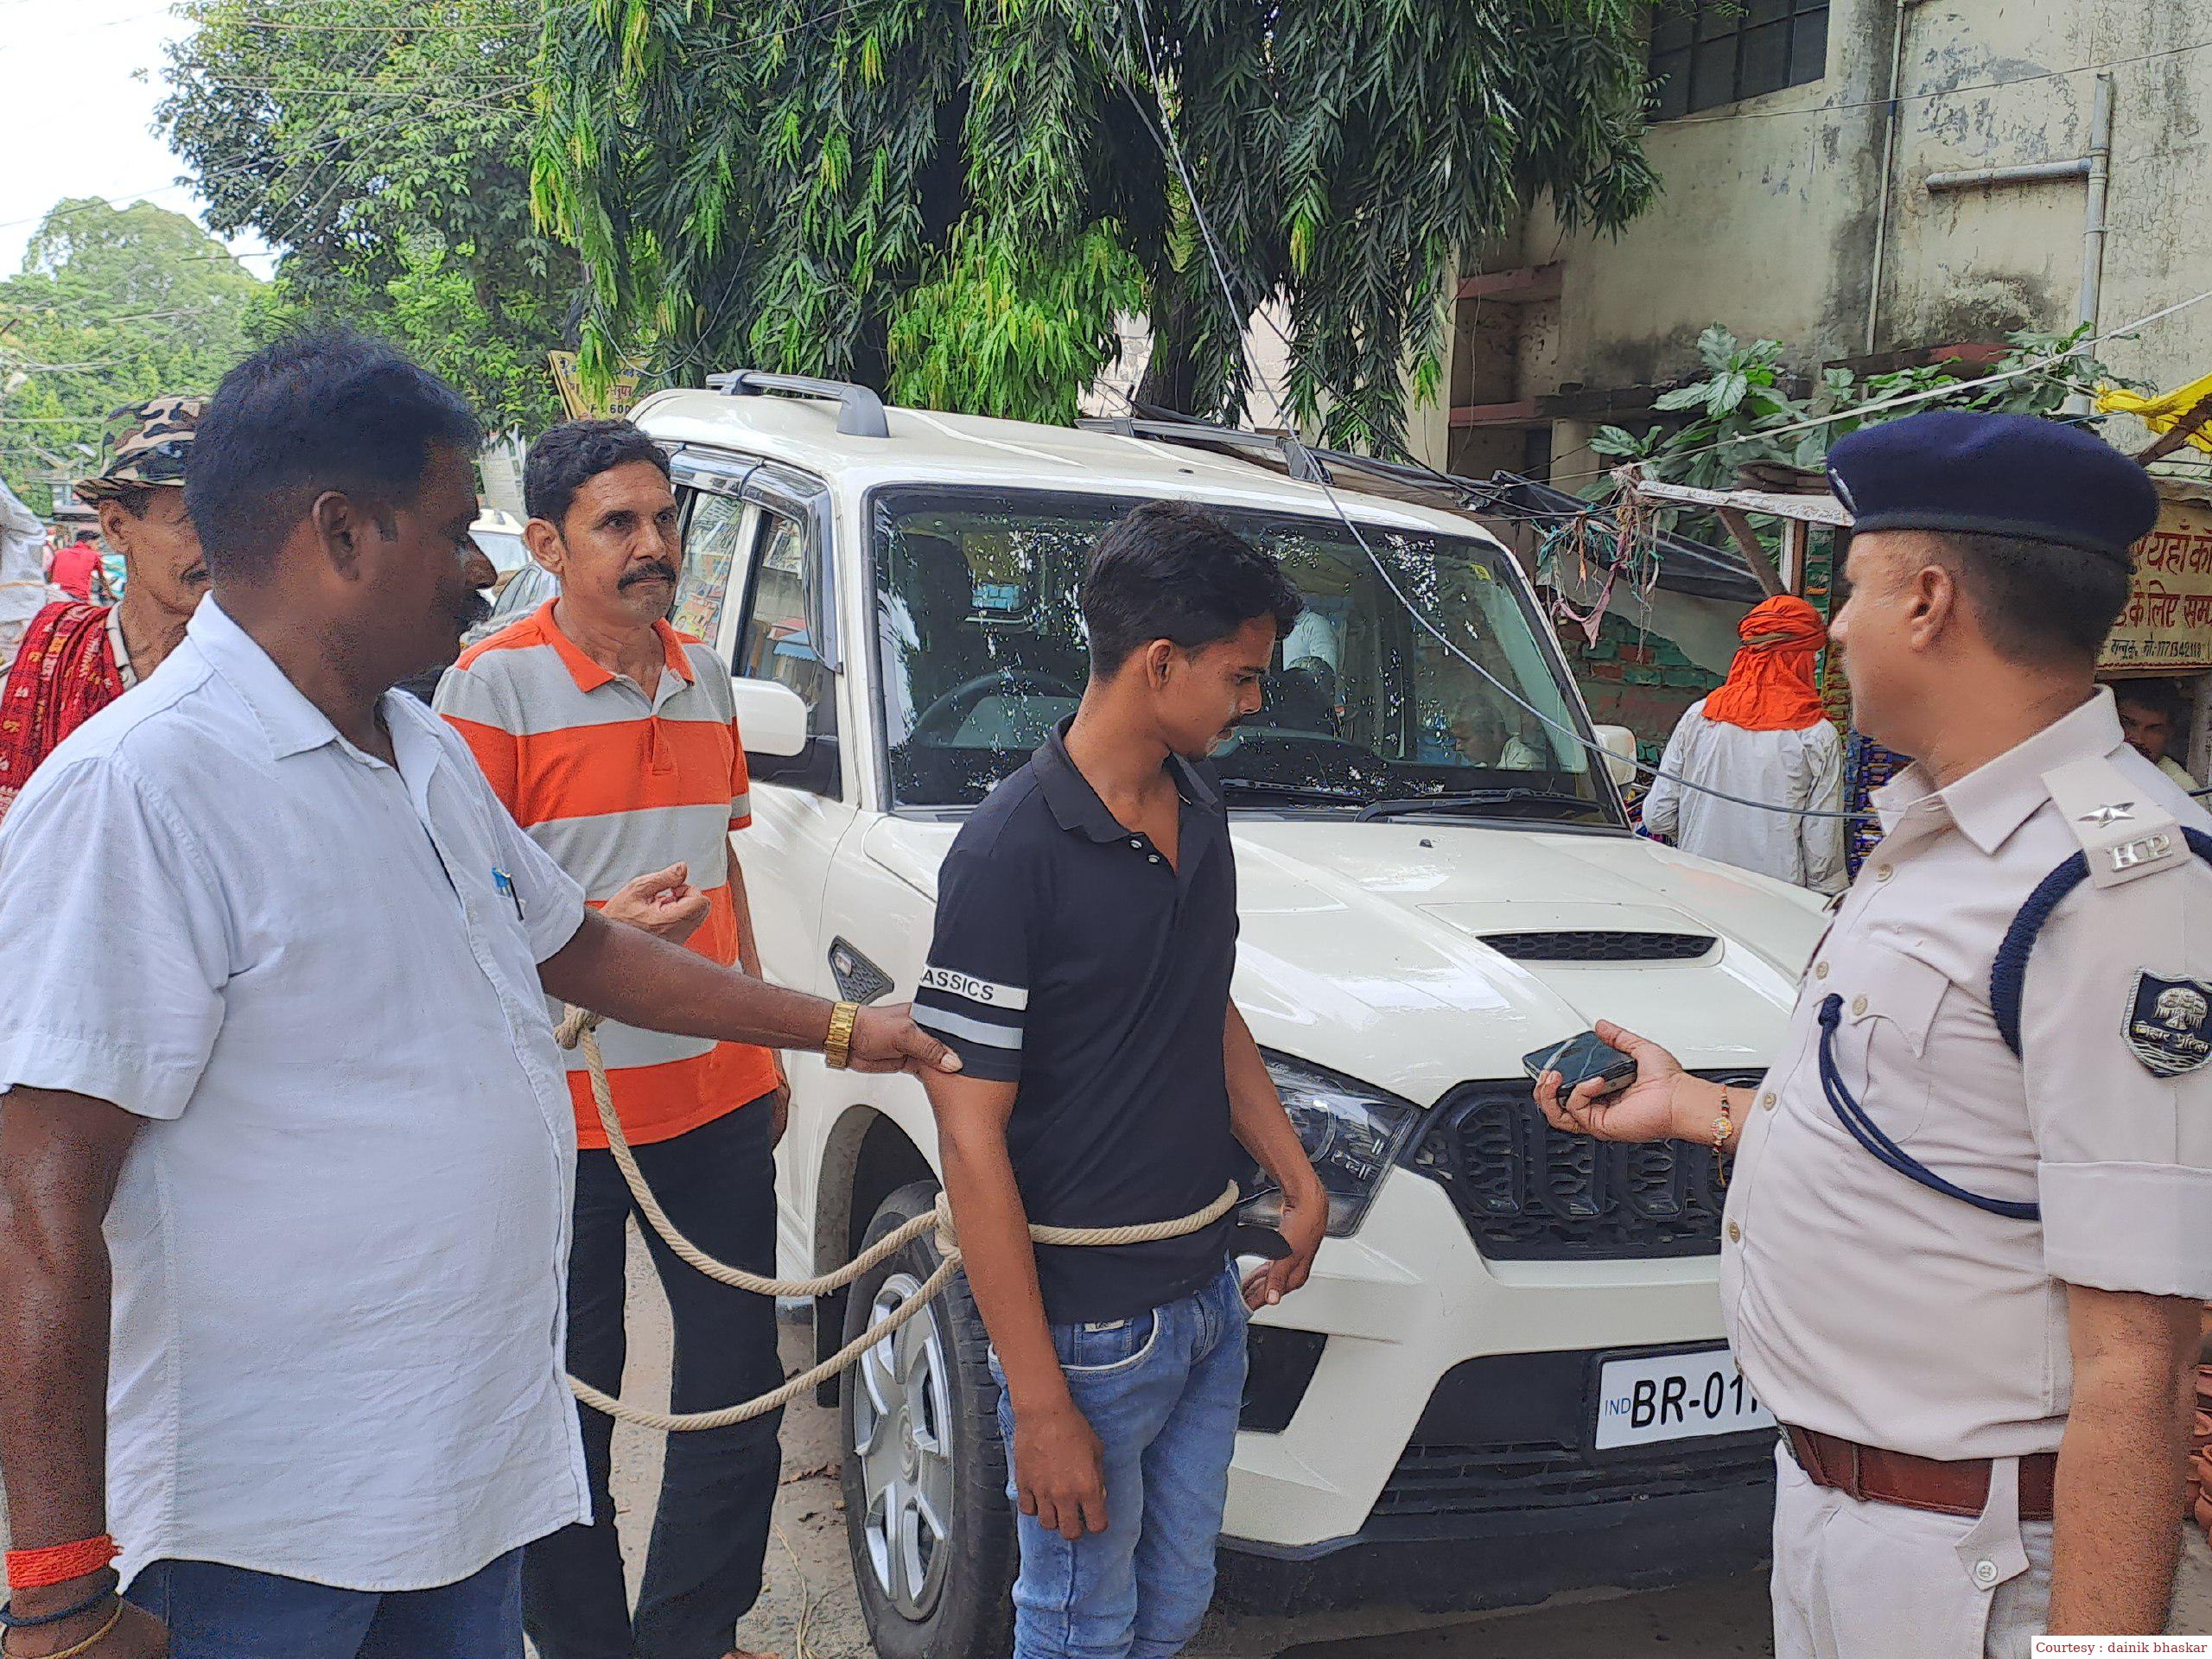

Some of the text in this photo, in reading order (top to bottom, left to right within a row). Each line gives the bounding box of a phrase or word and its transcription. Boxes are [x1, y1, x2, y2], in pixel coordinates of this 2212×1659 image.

[2184, 594, 2212, 630] सम
[921, 969, 995, 1001] ASSICS
[1605, 1370, 1758, 1429] IND BR-01
